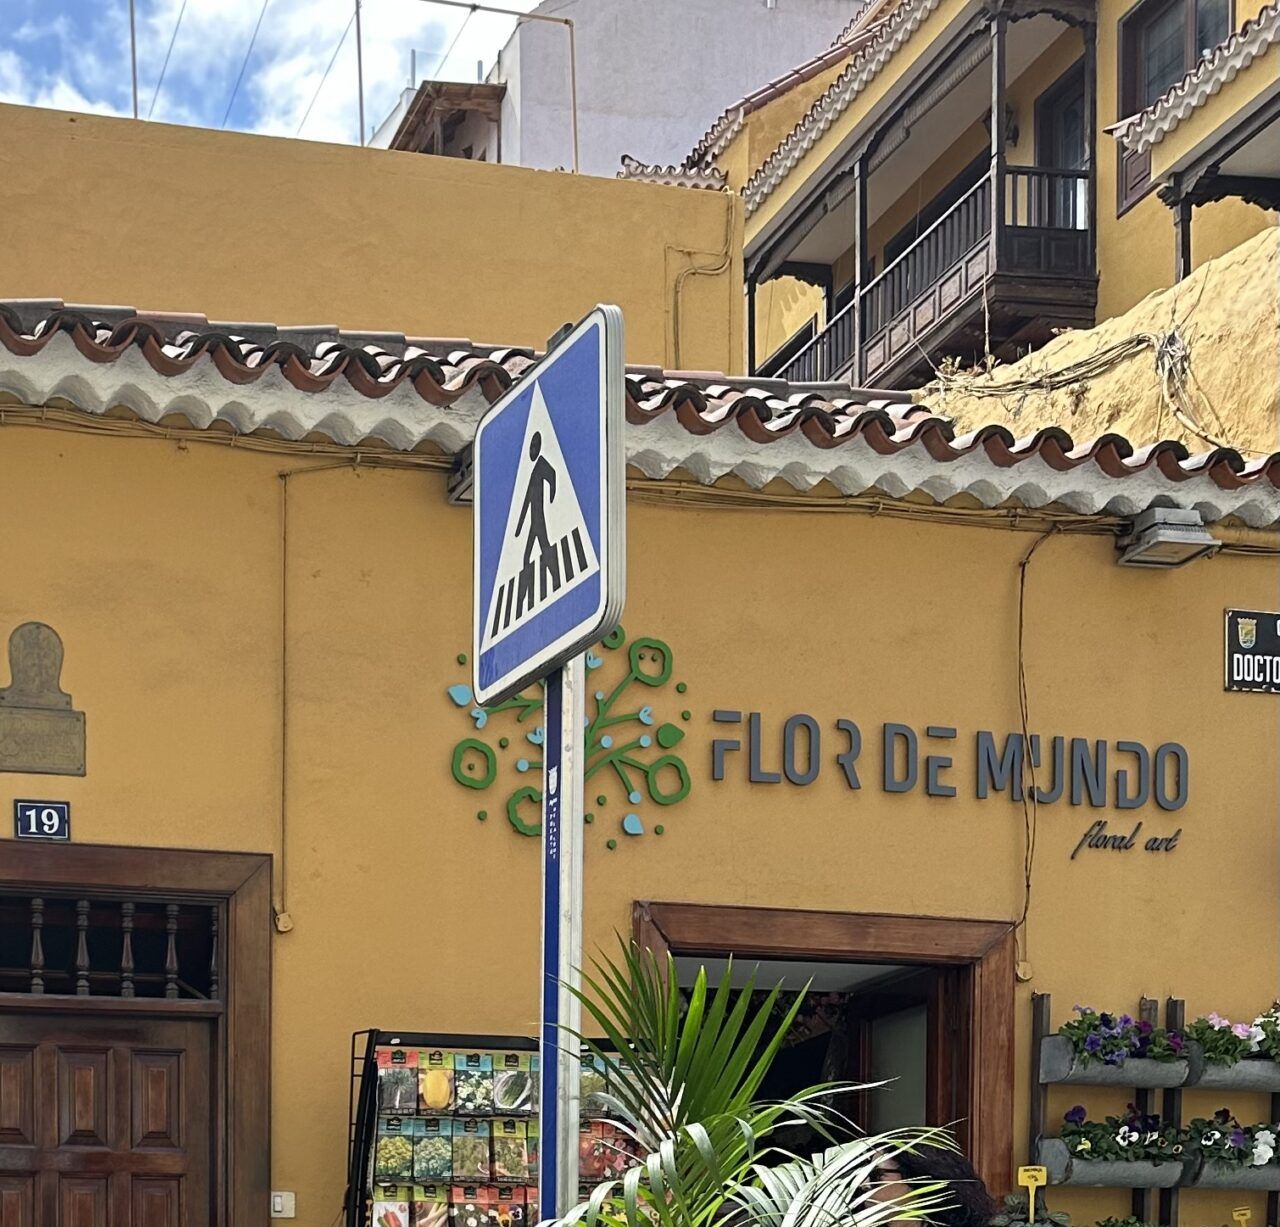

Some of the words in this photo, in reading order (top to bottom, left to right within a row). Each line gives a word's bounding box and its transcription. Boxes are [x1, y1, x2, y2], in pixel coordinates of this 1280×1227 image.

[1233, 653, 1280, 683] DOCTO
[712, 710, 862, 790] FLOR
[884, 721, 957, 798] DE
[976, 731, 1190, 812] MUNDO
[25, 808, 60, 834] 19
[1071, 820, 1138, 860] floral
[1144, 829, 1181, 853] art
